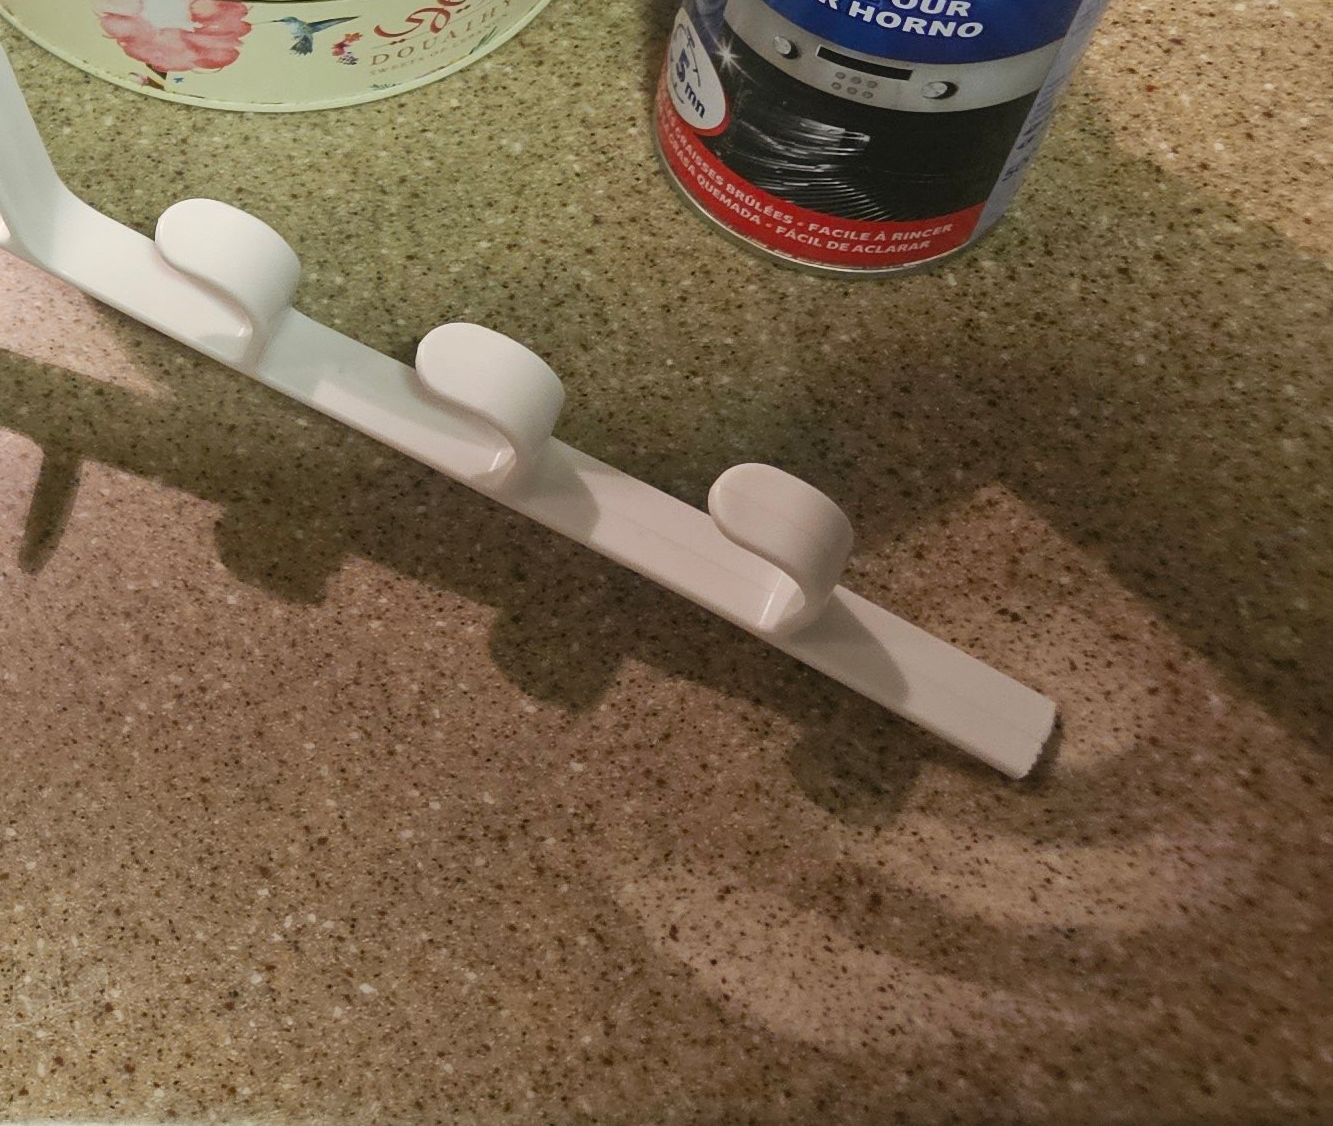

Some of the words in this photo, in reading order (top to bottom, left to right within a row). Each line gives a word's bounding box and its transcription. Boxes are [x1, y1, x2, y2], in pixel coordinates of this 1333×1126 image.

[848, 5, 983, 38] HORNO
[675, 49, 690, 80] 5
[685, 82, 705, 119] mn
[668, 134, 696, 177] GRASA
[697, 174, 762, 225] QUEMADA
[776, 225, 822, 247] FÁCIL
[826, 241, 849, 252] DE
[851, 240, 931, 254] ACLARAR
[674, 127, 724, 186] GRAISSES
[726, 183, 794, 224] BRÛLÉES
[808, 223, 870, 241] FACILE
[874, 230, 886, 242] À
[891, 224, 954, 242] RINCER
